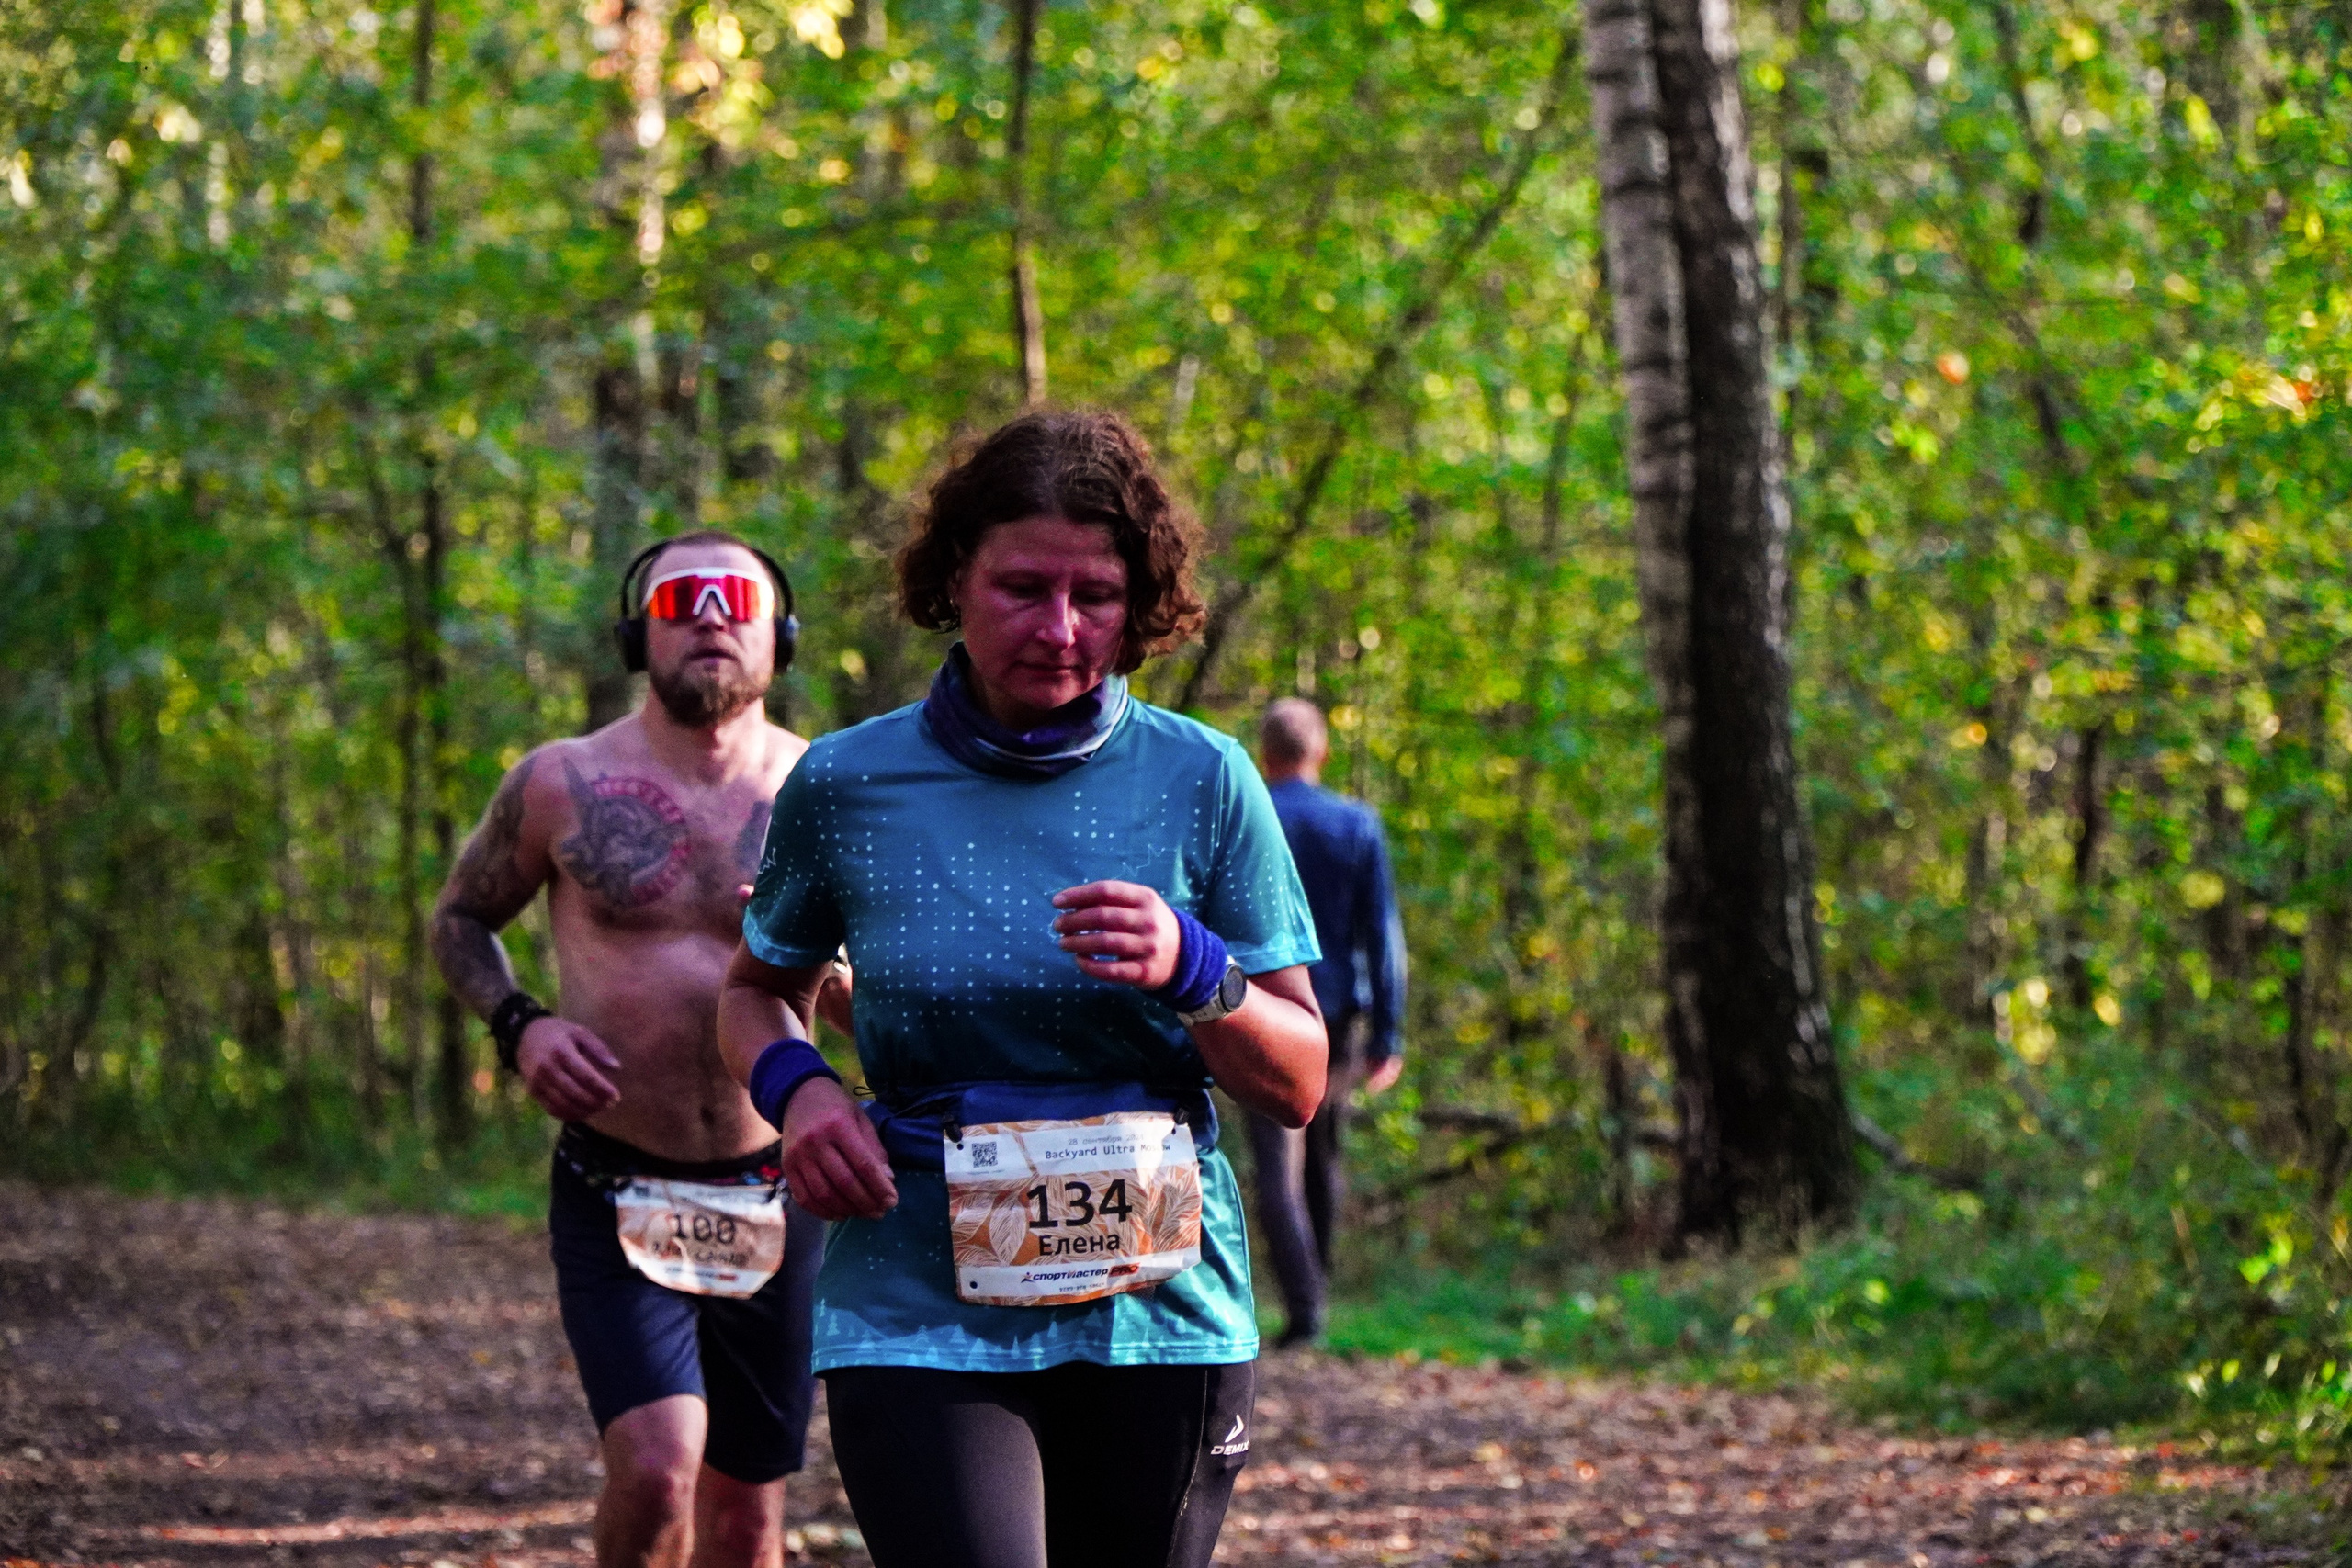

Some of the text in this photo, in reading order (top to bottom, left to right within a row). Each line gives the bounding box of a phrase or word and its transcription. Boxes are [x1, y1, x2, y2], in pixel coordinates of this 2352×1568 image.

[1045, 1146, 1097, 1159] Backyard
[1103, 1145, 1135, 1156] Ultra
[1026, 1179, 1132, 1229] 134
[672, 1213, 736, 1244] 100
[1039, 1233, 1121, 1257] Елена
[1210, 1440, 1250, 1456] DEMIX
